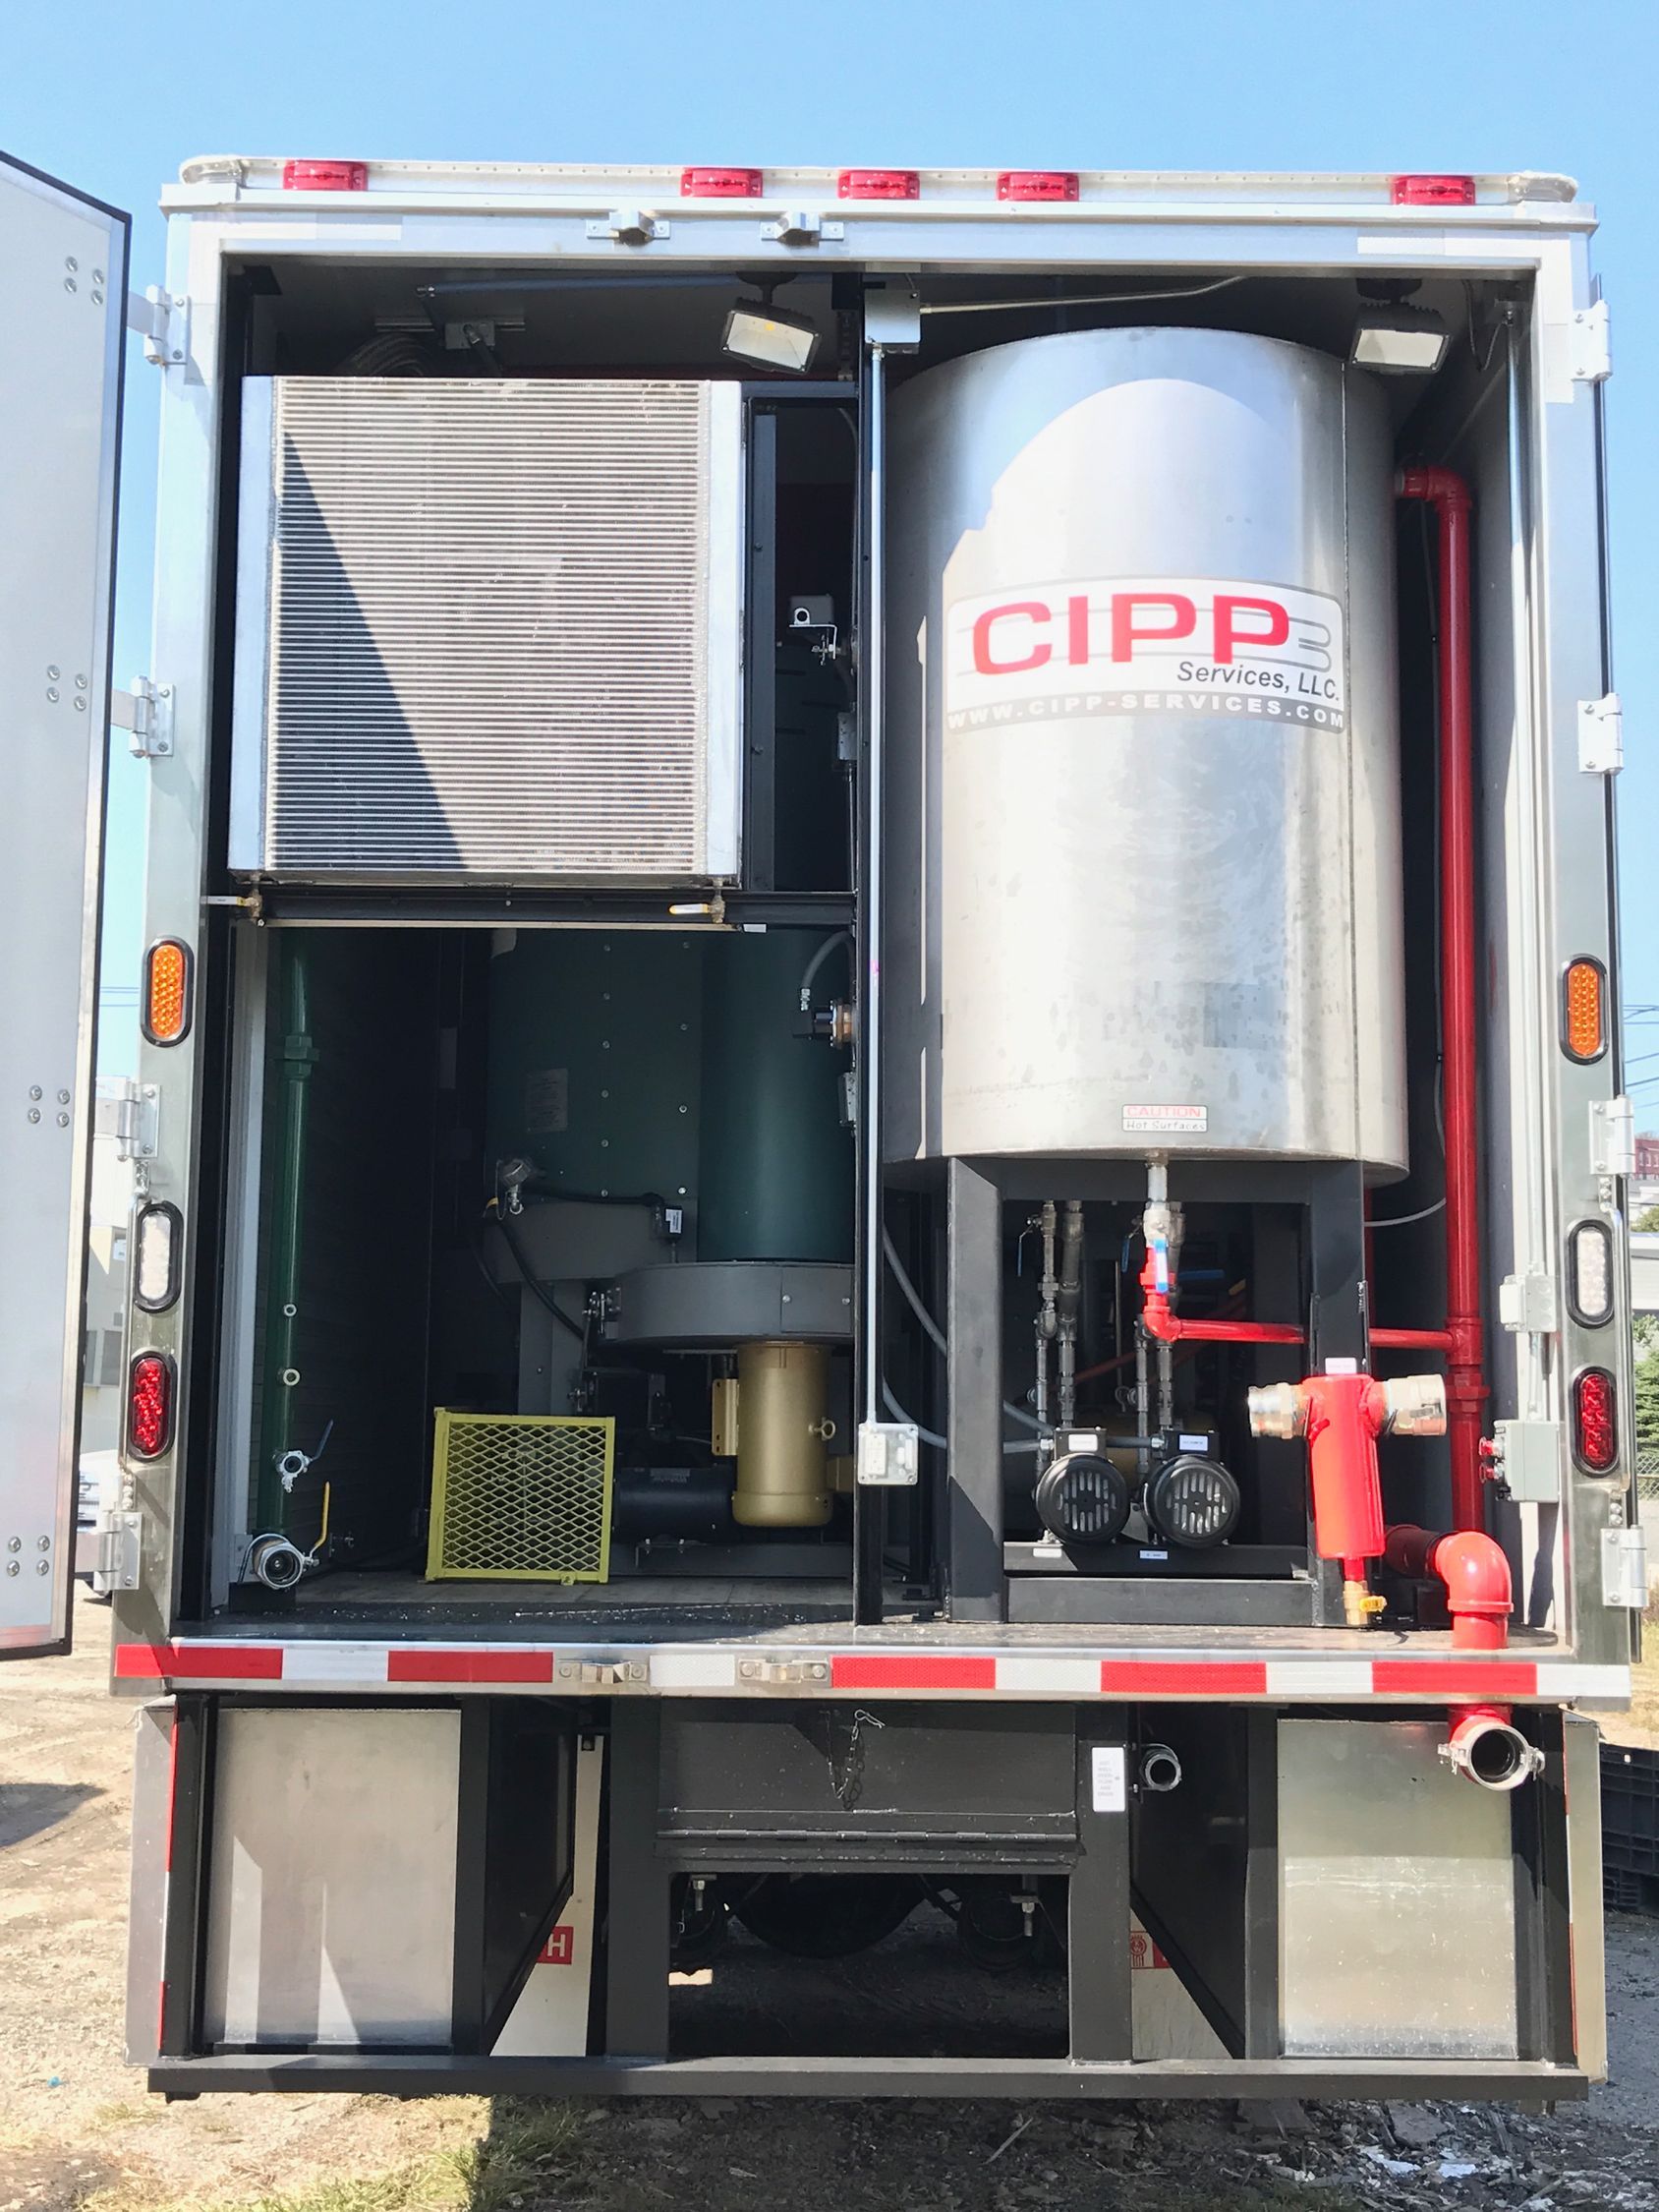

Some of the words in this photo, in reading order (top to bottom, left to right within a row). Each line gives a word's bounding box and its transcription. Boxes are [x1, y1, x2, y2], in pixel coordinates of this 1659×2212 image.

[973, 593, 1289, 675] CIPP
[1177, 662, 1290, 694] Services,
[1297, 672, 1341, 702] LLC.
[948, 693, 1344, 729] WWW.CIPP-SERVICES.COM
[1126, 1106, 1201, 1118] CAUTION
[1126, 1120, 1148, 1130] Hot
[1152, 1121, 1206, 1131] Surfaces
